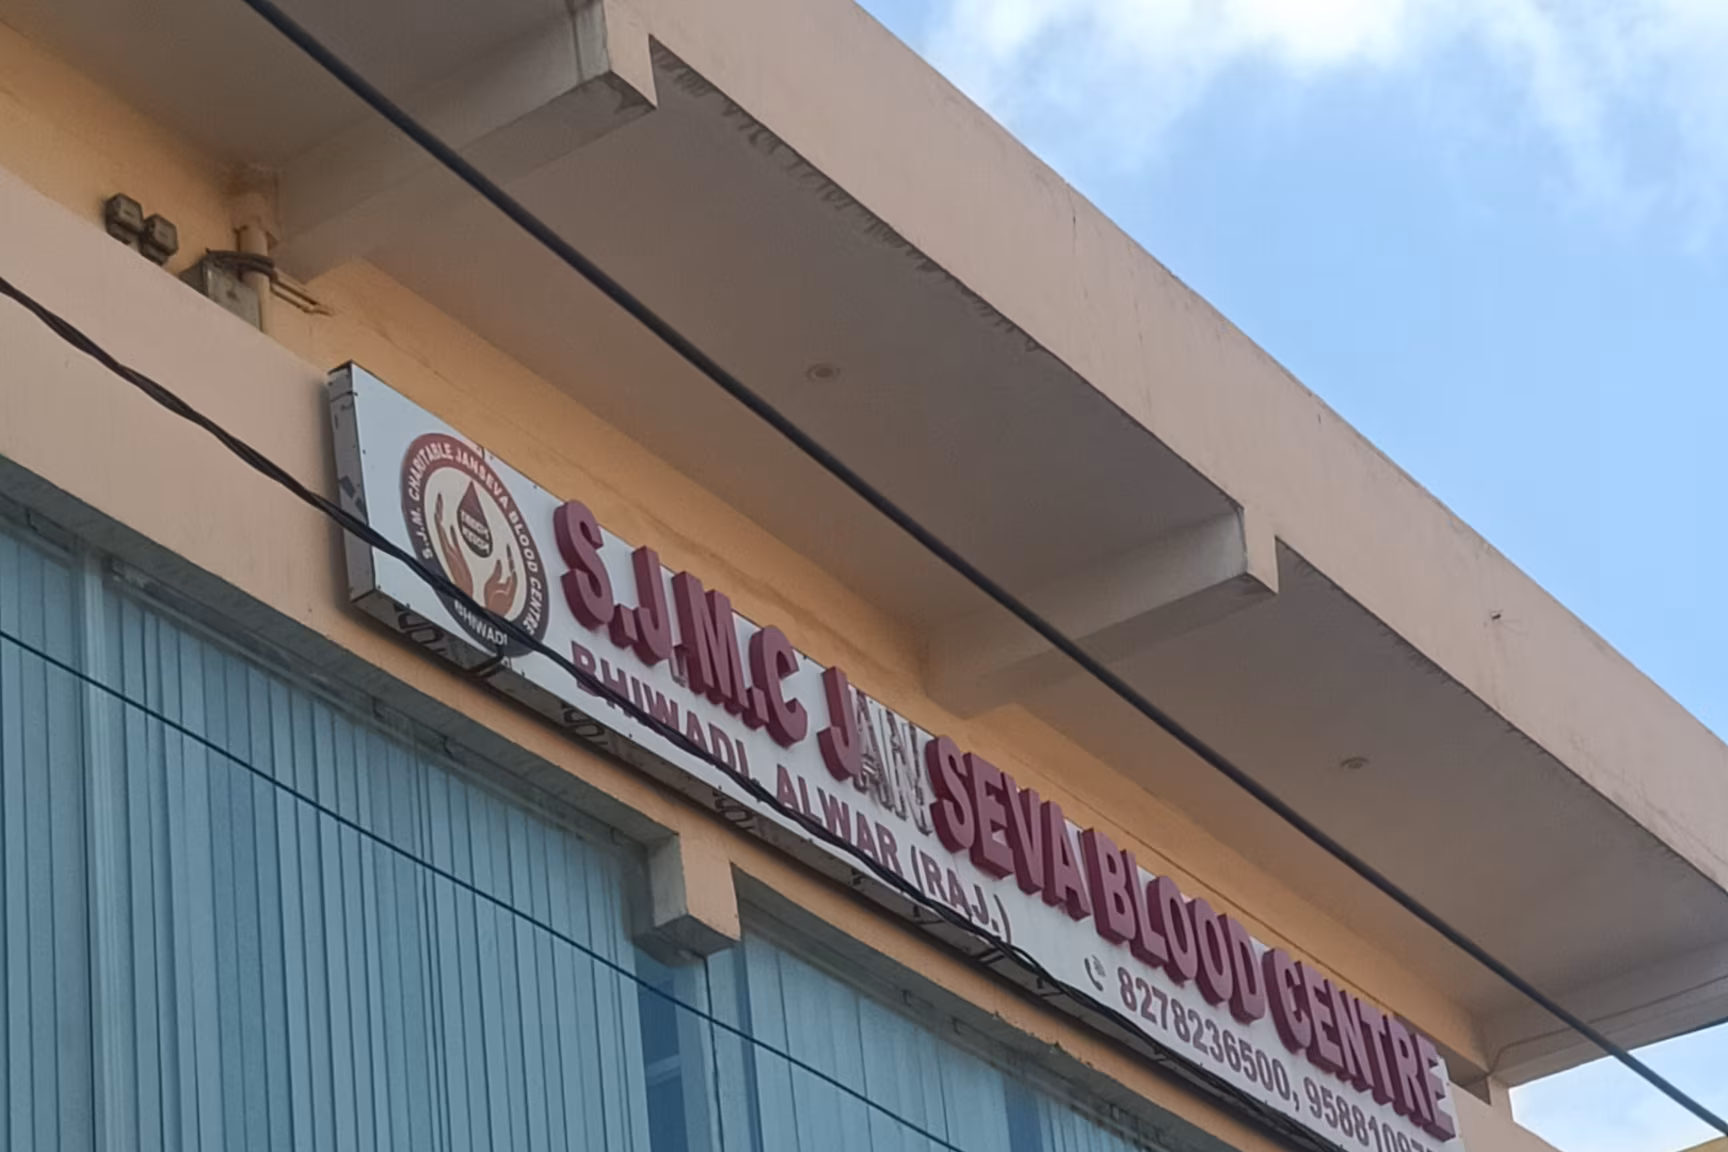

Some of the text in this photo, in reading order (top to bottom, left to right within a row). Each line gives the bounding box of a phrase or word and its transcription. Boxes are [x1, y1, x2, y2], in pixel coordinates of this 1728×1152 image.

[407, 443, 453, 501] CHARITABLE
[455, 447, 510, 508] JANSEVA
[508, 510, 539, 574] BLOOD
[454, 600, 509, 645] BHIWADI
[571, 640, 1012, 944] BHIWADI ALWAR (RAJ.)
[926, 736, 1091, 920] SEVA
[1080, 828, 1267, 1025] BLOOD
[1261, 947, 1456, 1143] CENTRE
[1118, 965, 1300, 1112] 8278236500,
